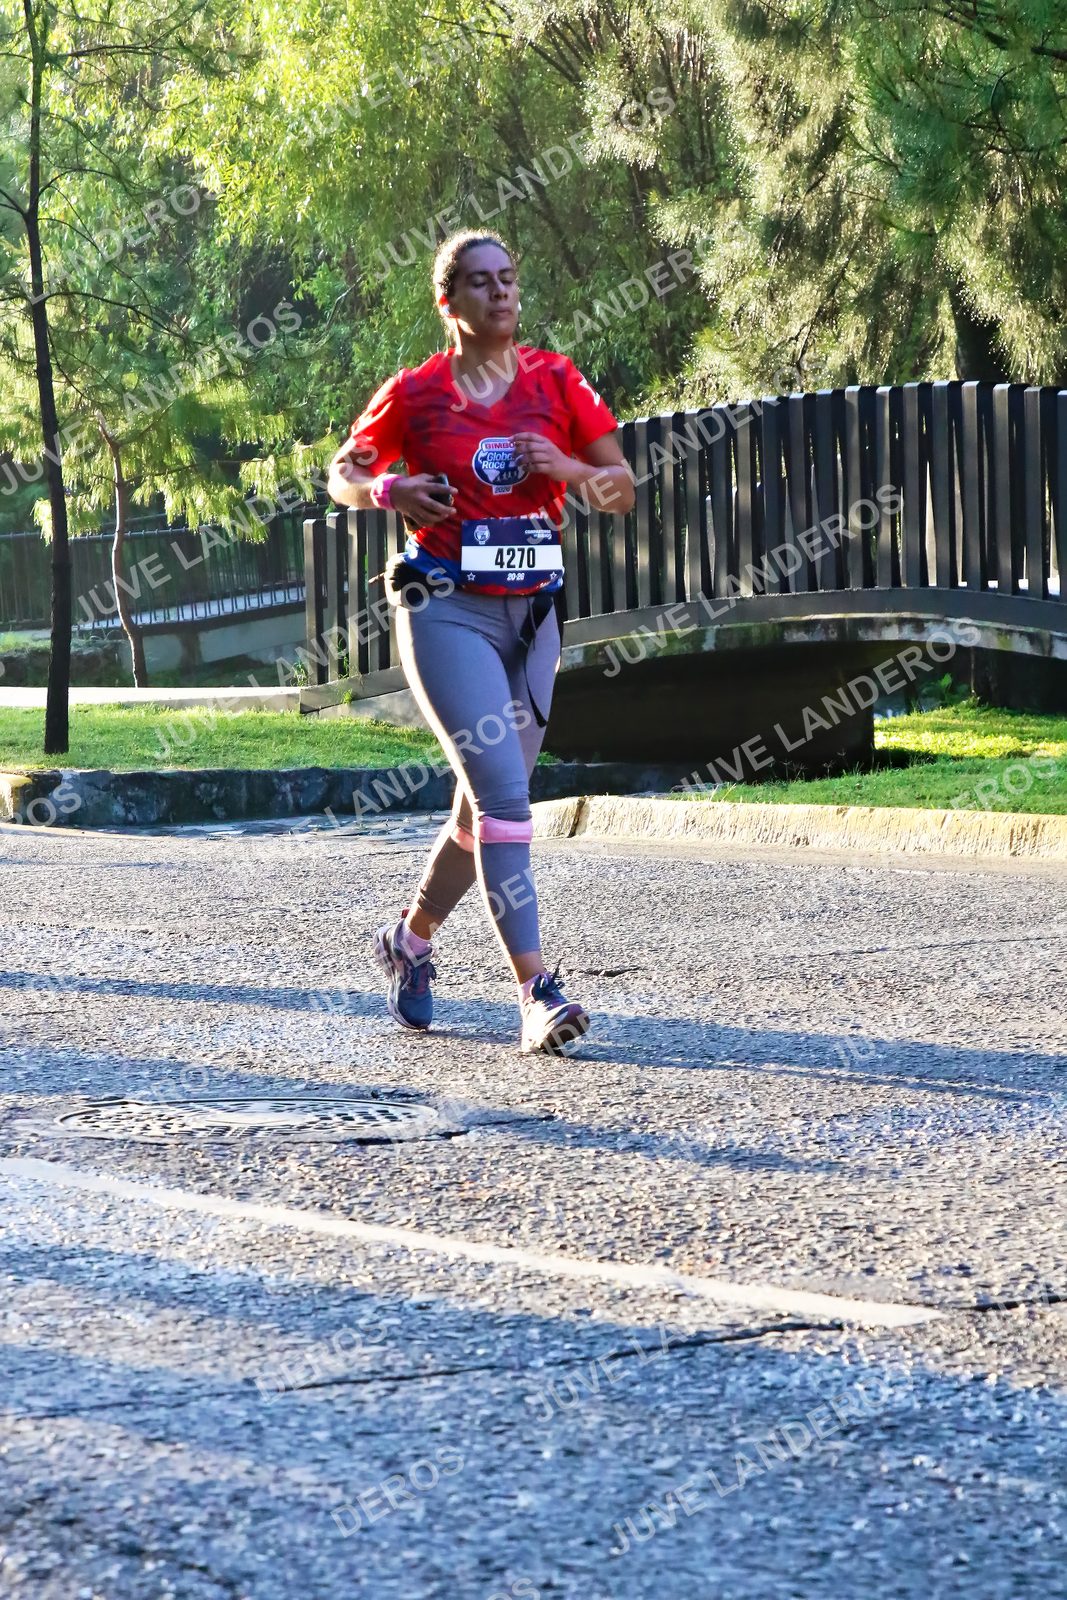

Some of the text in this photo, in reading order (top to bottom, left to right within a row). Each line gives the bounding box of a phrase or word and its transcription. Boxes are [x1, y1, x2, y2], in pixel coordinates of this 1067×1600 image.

[485, 441, 515, 449] BIMBO
[487, 451, 514, 462] Globa
[482, 460, 506, 469] Race
[494, 547, 536, 569] 4270
